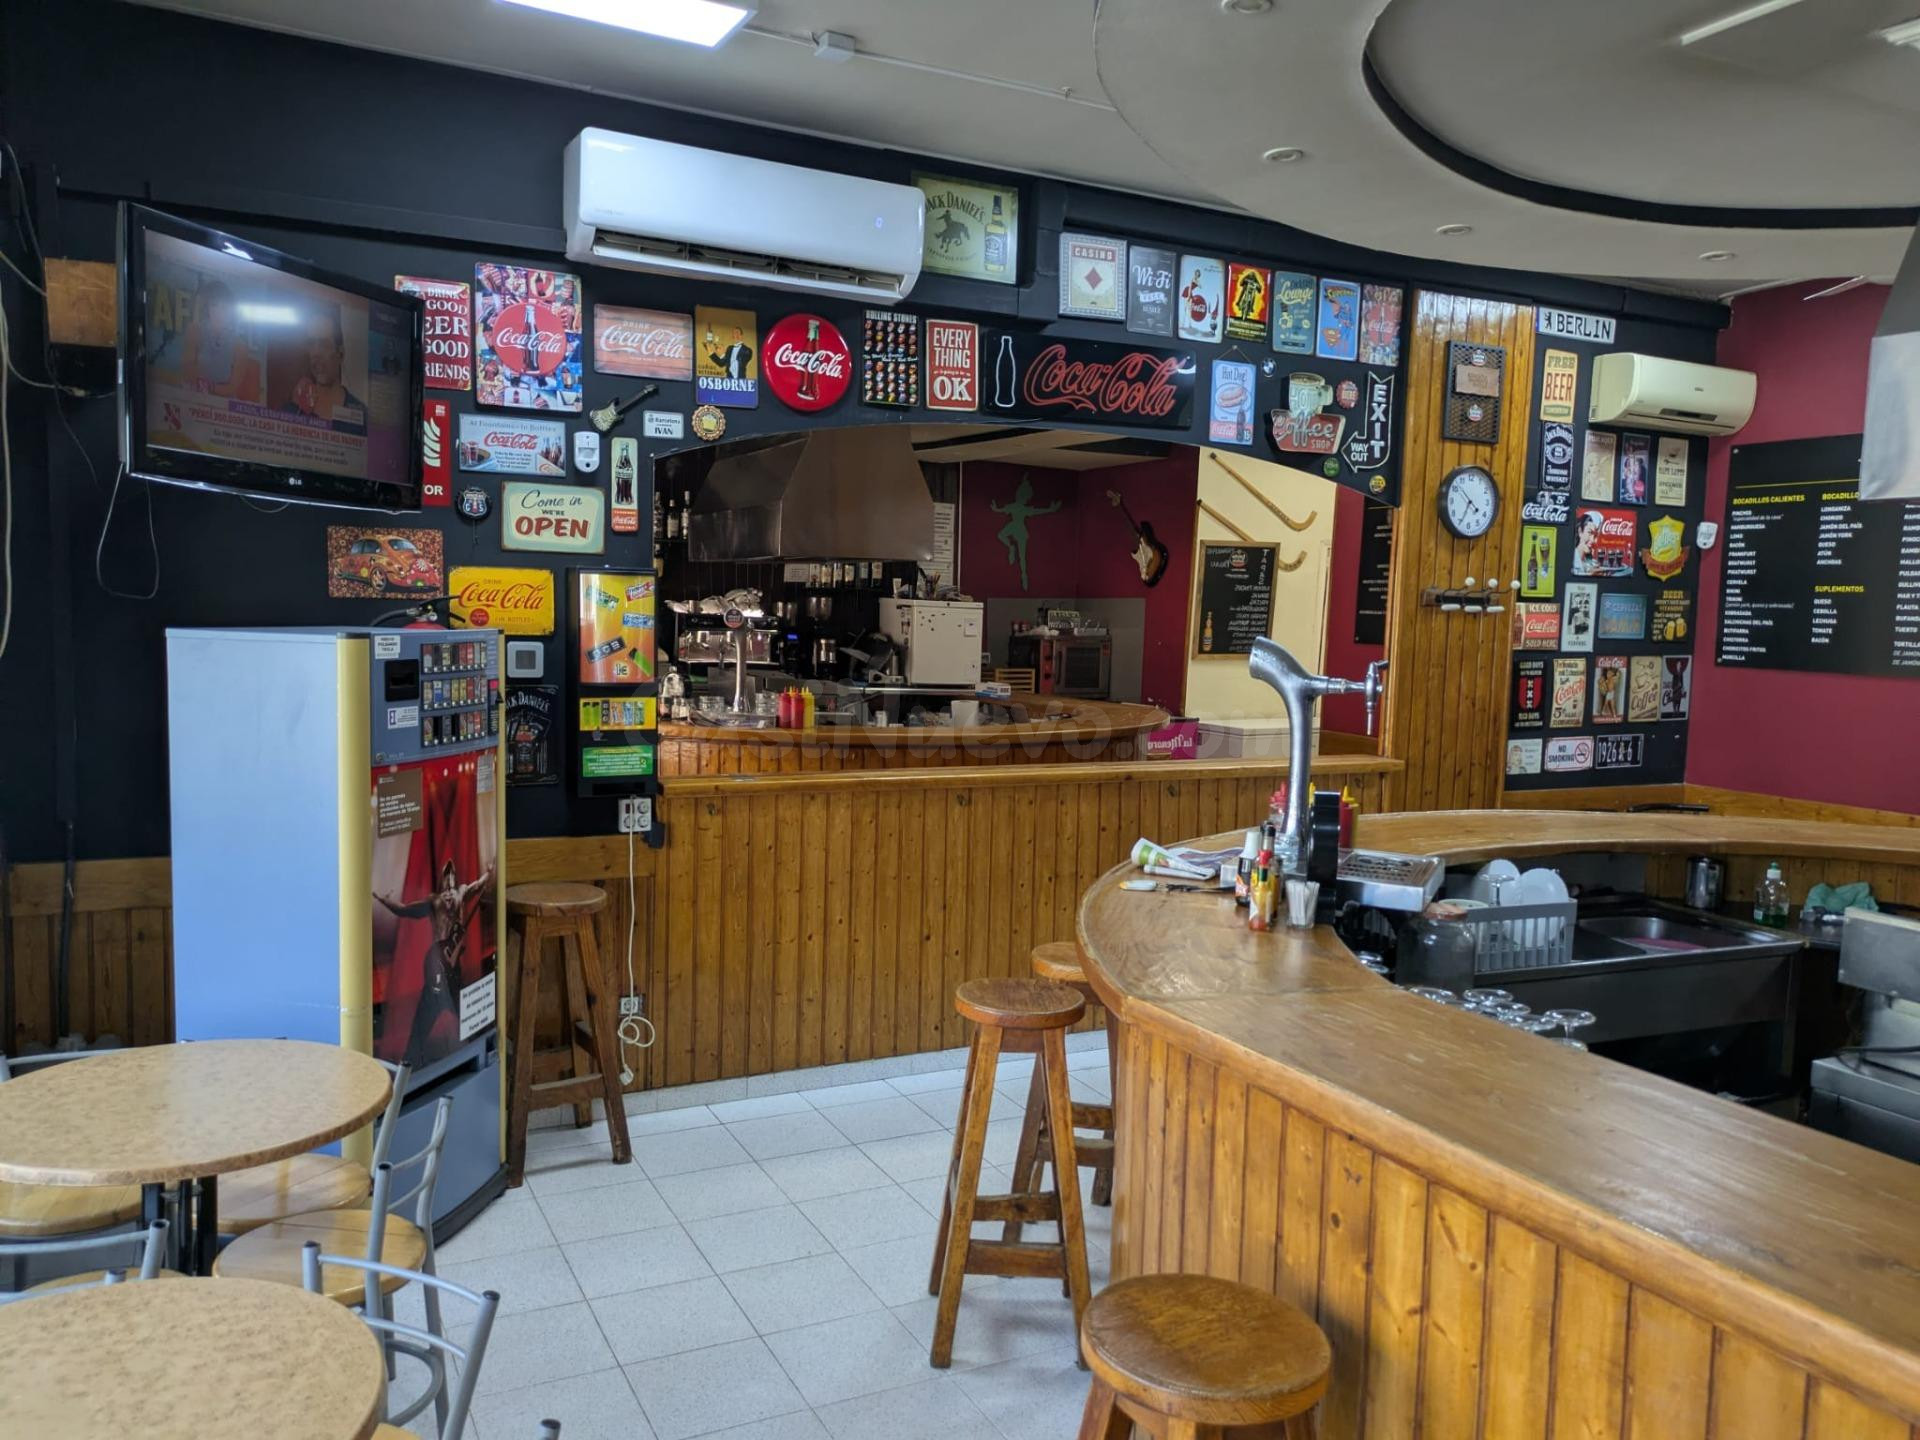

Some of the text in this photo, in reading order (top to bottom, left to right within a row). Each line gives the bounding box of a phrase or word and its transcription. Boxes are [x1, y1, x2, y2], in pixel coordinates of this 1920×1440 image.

[925, 195, 945, 213] ACK
[1074, 247, 1114, 261] CASINO
[426, 299, 468, 315] GOOD
[866, 310, 891, 322] ROLLING
[424, 316, 470, 337] EER
[1556, 313, 1611, 340] BERLIN
[496, 327, 563, 356] Coca-Cola
[600, 325, 689, 358] Coca-Cola
[933, 328, 972, 349] EVERY
[774, 343, 845, 378] Coca-Cola
[933, 347, 971, 369] THING
[1548, 356, 1577, 369] FREE
[424, 362, 471, 381] RIENDS
[1023, 344, 1189, 417] Coca-Cola
[699, 378, 756, 392] OSBORNE
[933, 376, 972, 402] OK
[1545, 373, 1574, 401] BEER
[1271, 410, 1336, 448] Coffee
[1370, 383, 1388, 459] EXIT
[484, 431, 538, 450] Coca-Cola
[1311, 439, 1332, 449] SHOP
[1351, 442, 1369, 452] WAY
[1351, 453, 1369, 462] OUT
[424, 485, 443, 496] OR
[521, 489, 583, 509] Come in
[1733, 494, 1806, 505] BOCADILLOS CALIENTES
[1822, 491, 1861, 501] BOCADILLO
[1522, 503, 1570, 522] Coca-Cola
[515, 516, 589, 539] OPEN
[1601, 519, 1634, 537] Coca-Cola
[458, 582, 546, 609] Coca-Cola
[1814, 585, 1864, 593] SUPLEMENTOS
[1548, 753, 1575, 764] SMOKING
[1558, 745, 1567, 753] NO
